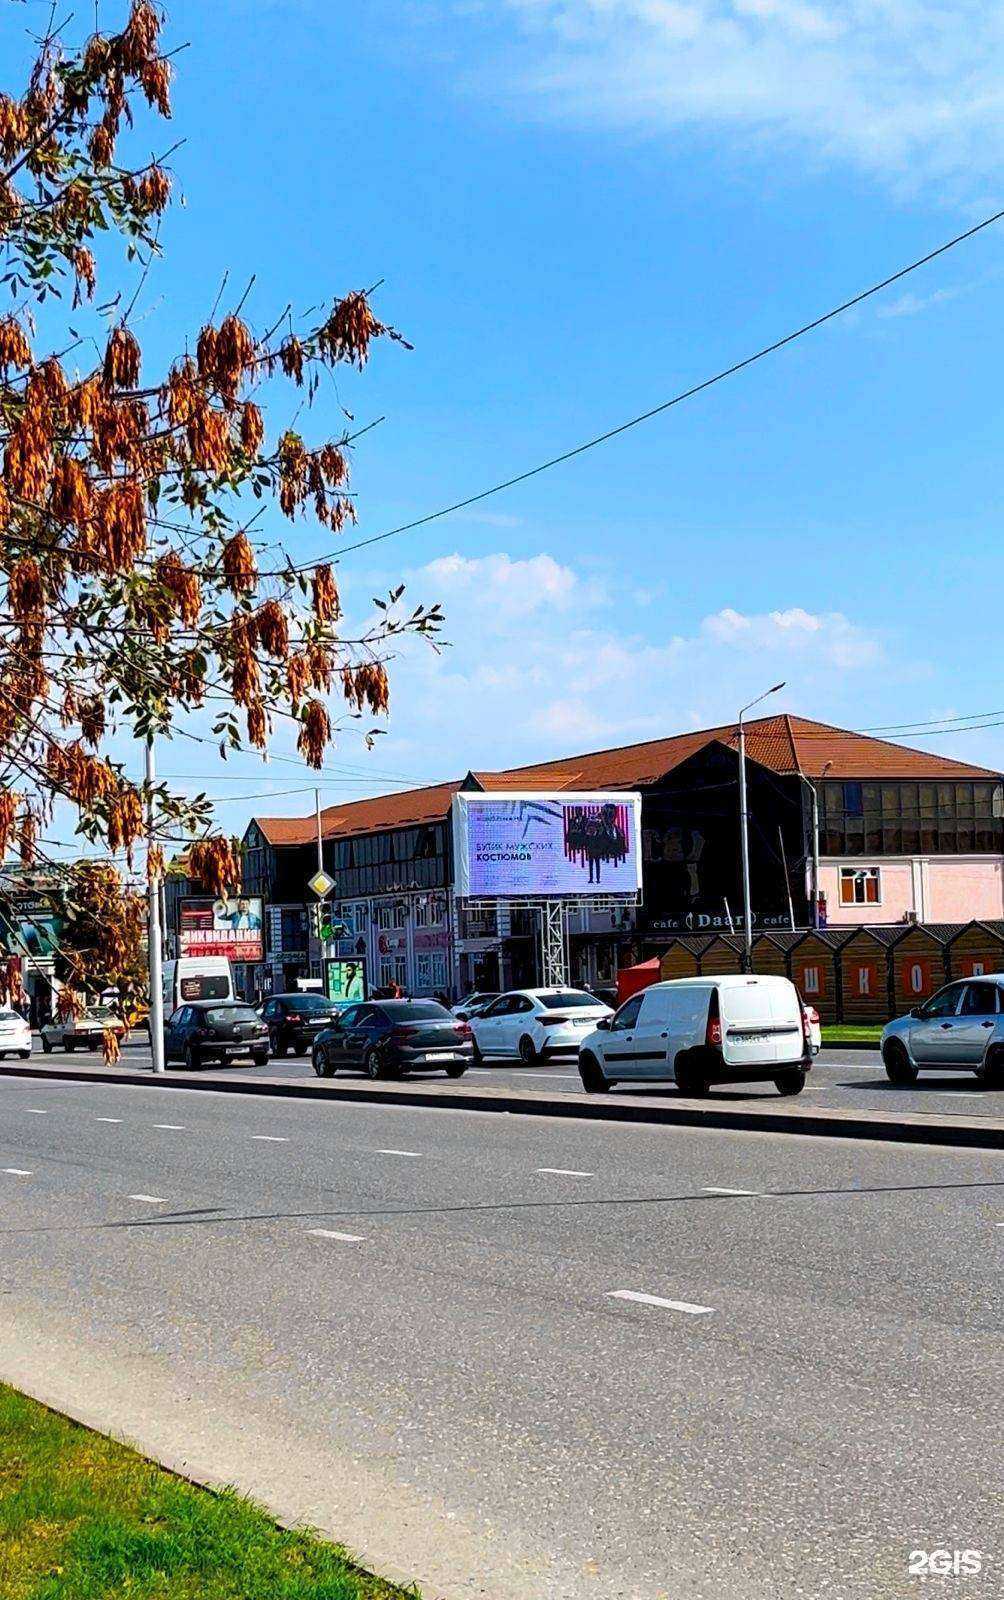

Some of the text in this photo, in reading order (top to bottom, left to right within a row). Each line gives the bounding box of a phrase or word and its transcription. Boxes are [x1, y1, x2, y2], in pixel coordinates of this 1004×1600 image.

[476, 853, 532, 862] КОСТЮМОВ
[653, 914, 790, 929] cafe Daar cafe
